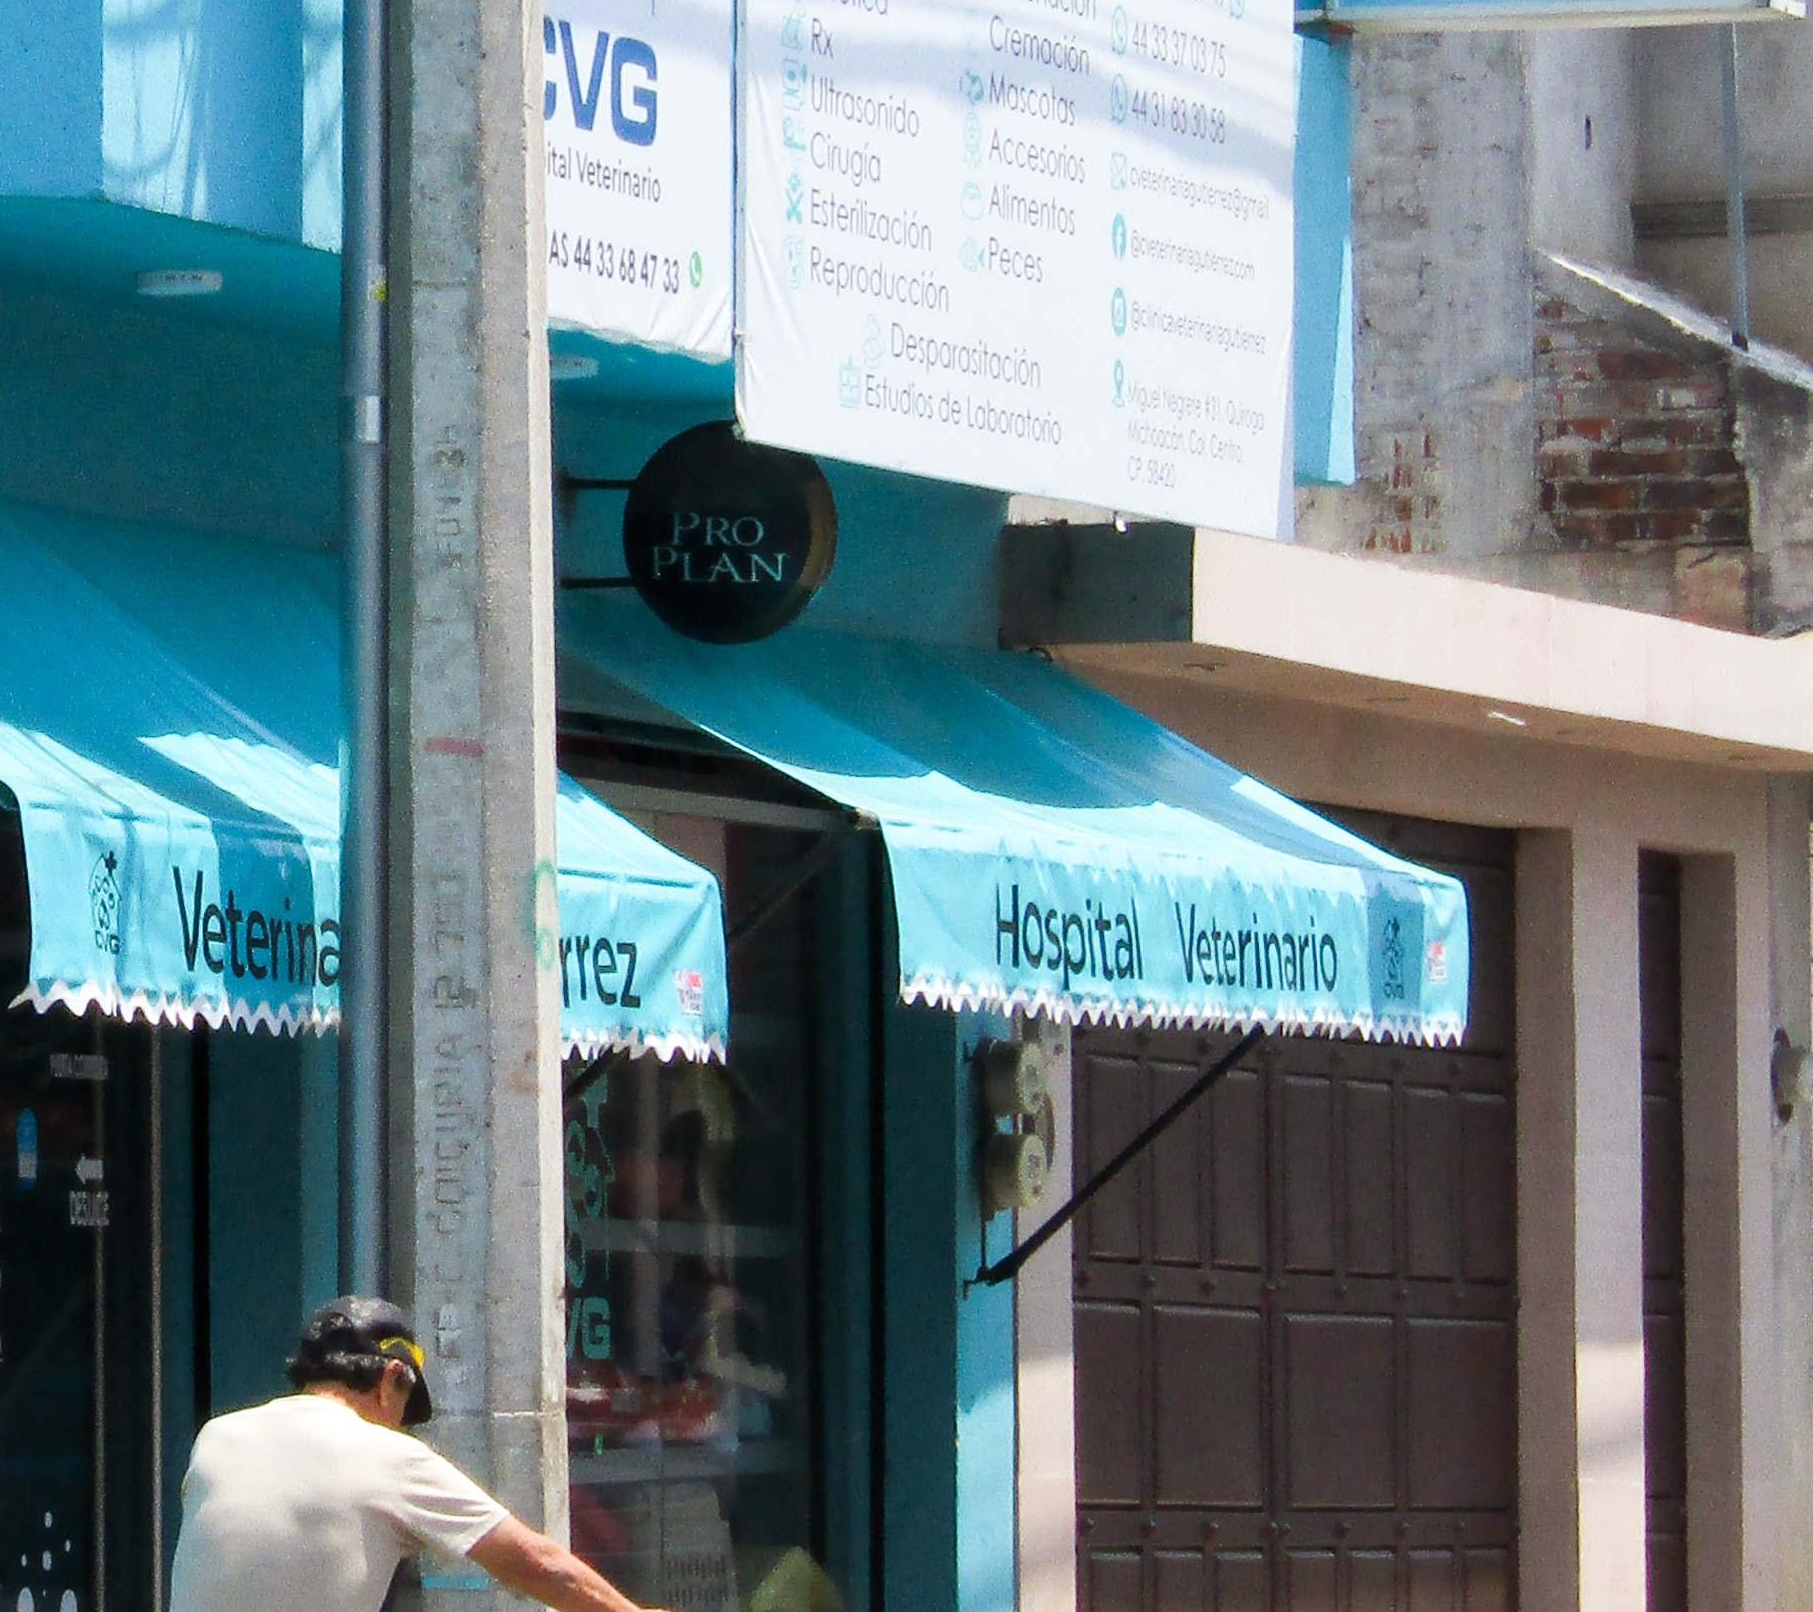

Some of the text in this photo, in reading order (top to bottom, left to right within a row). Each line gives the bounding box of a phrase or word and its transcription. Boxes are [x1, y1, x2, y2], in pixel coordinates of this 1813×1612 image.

[811, 17, 834, 58] Rx
[989, 14, 1090, 75] Cremación
[1131, 20, 1226, 78] 44 33 37 03 75
[810, 74, 920, 137] Ultrasonido
[989, 71, 1076, 126] Mascotas
[1131, 88, 1147, 123] 44
[1151, 90, 1166, 128] 31
[1171, 96, 1188, 134] 83
[1209, 107, 1226, 145] 58
[546, 140, 661, 203] ital Veterinario
[810, 131, 882, 187] Cirugía
[988, 127, 1085, 184] Accesorios
[810, 188, 932, 252] Esterilización
[988, 183, 1076, 235] Alimentos
[573, 235, 592, 274] 44
[596, 241, 615, 279] 33
[619, 247, 636, 285] 68
[641, 251, 658, 289] 47
[662, 257, 680, 294] 33
[810, 245, 950, 312] Reproducción
[988, 237, 1043, 283] Peces
[891, 321, 1042, 389] Desparasitación
[865, 374, 1062, 445] Estudios de Laboratorio
[672, 511, 765, 547] PRO
[652, 546, 788, 583] PLAN
[172, 866, 341, 987] Veterina
[559, 933, 641, 1009] rrez
[995, 883, 1143, 989] Hospital
[1175, 902, 1338, 992] Veterinario
